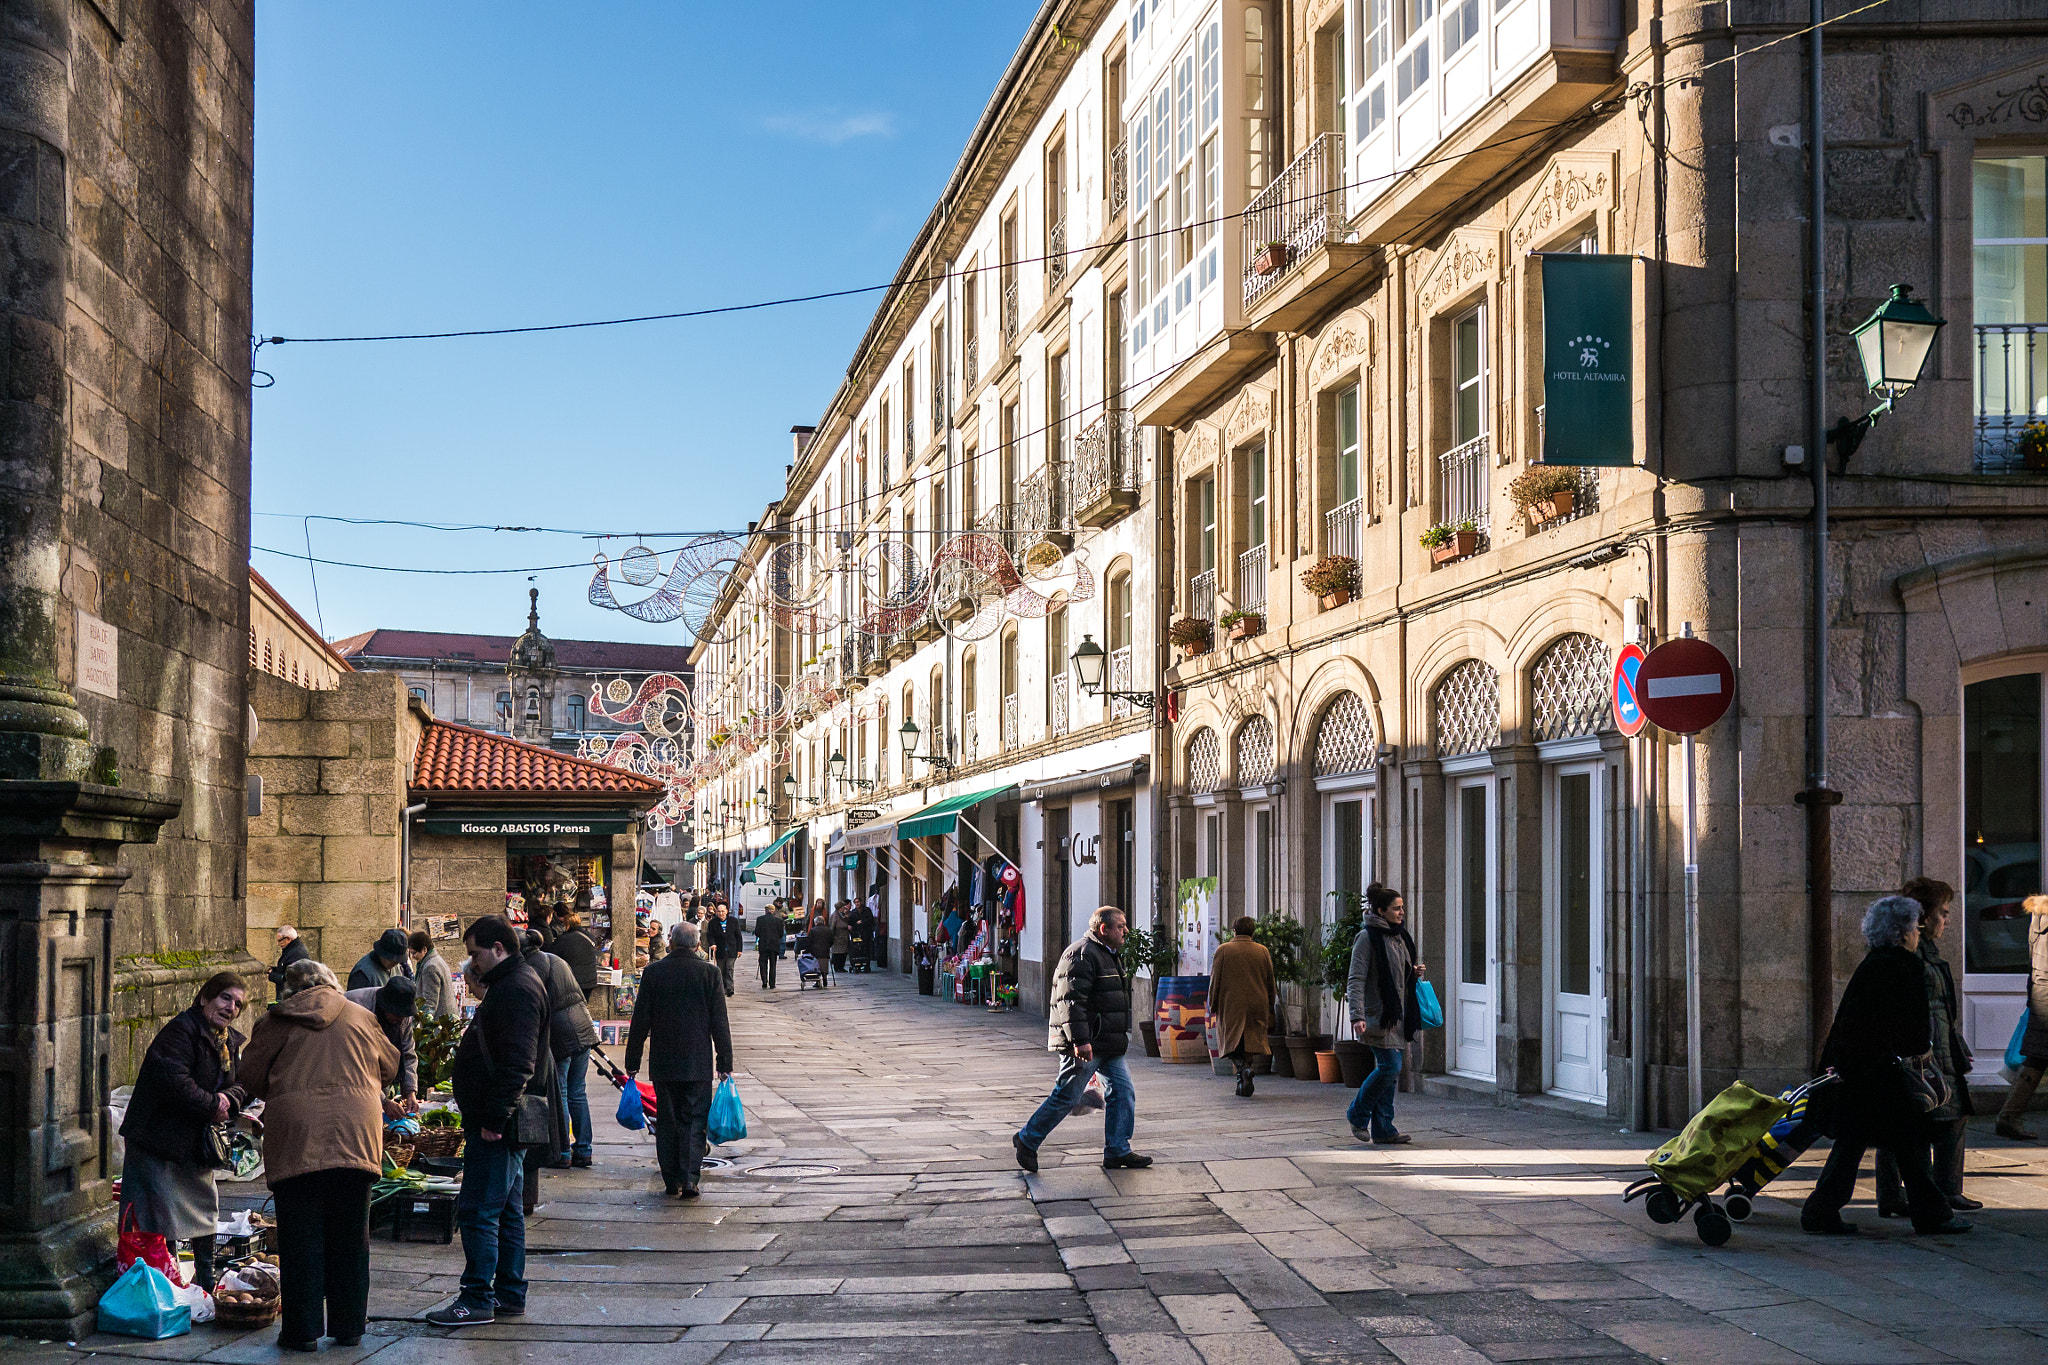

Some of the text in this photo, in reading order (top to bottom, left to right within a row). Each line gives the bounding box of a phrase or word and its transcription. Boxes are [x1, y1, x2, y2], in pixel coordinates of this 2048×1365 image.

[1553, 371, 1626, 382] HOTEL ALTAMIRA
[101, 628, 108, 645] DE
[90, 646, 107, 664] SANTO
[461, 823, 591, 834] Kiosco ABASTOS Prensa
